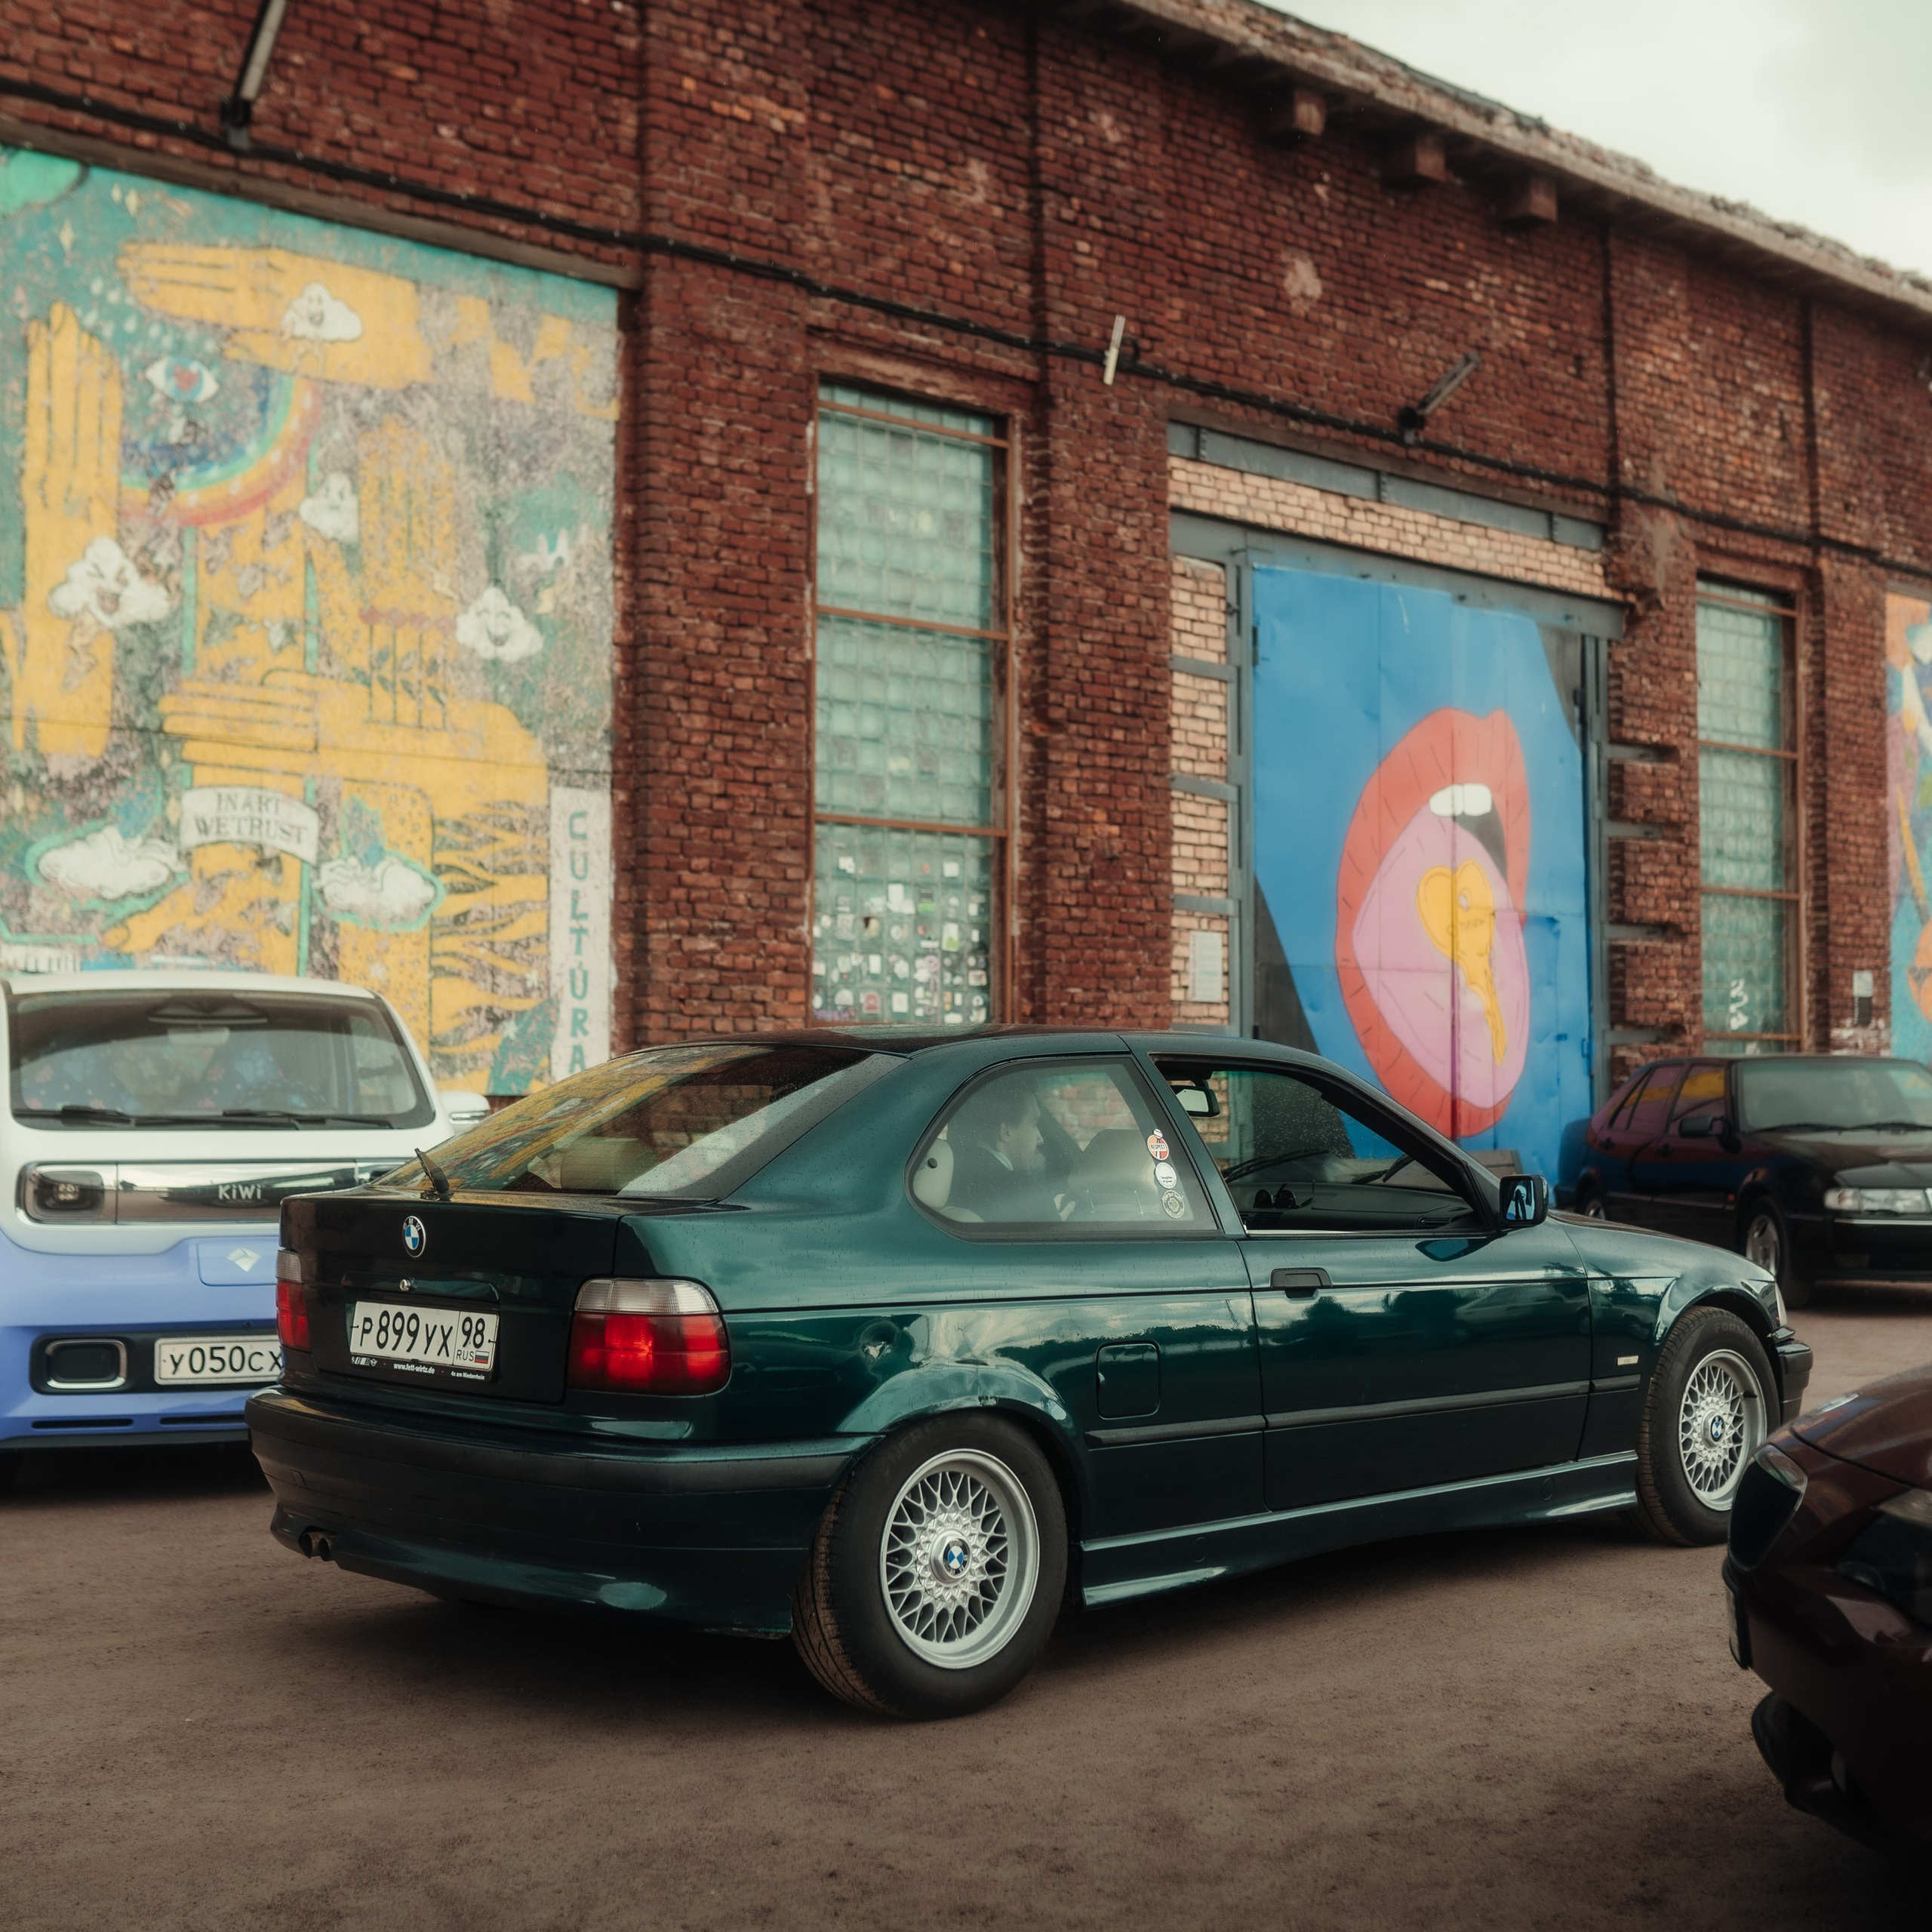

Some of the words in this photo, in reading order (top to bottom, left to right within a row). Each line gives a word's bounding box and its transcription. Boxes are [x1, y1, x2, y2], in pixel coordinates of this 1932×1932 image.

[217, 793, 238, 812] IN
[194, 814, 228, 836] WE
[229, 817, 308, 844] TRUST
[461, 1315, 486, 1349] 98
[457, 1349, 475, 1361] RUS
